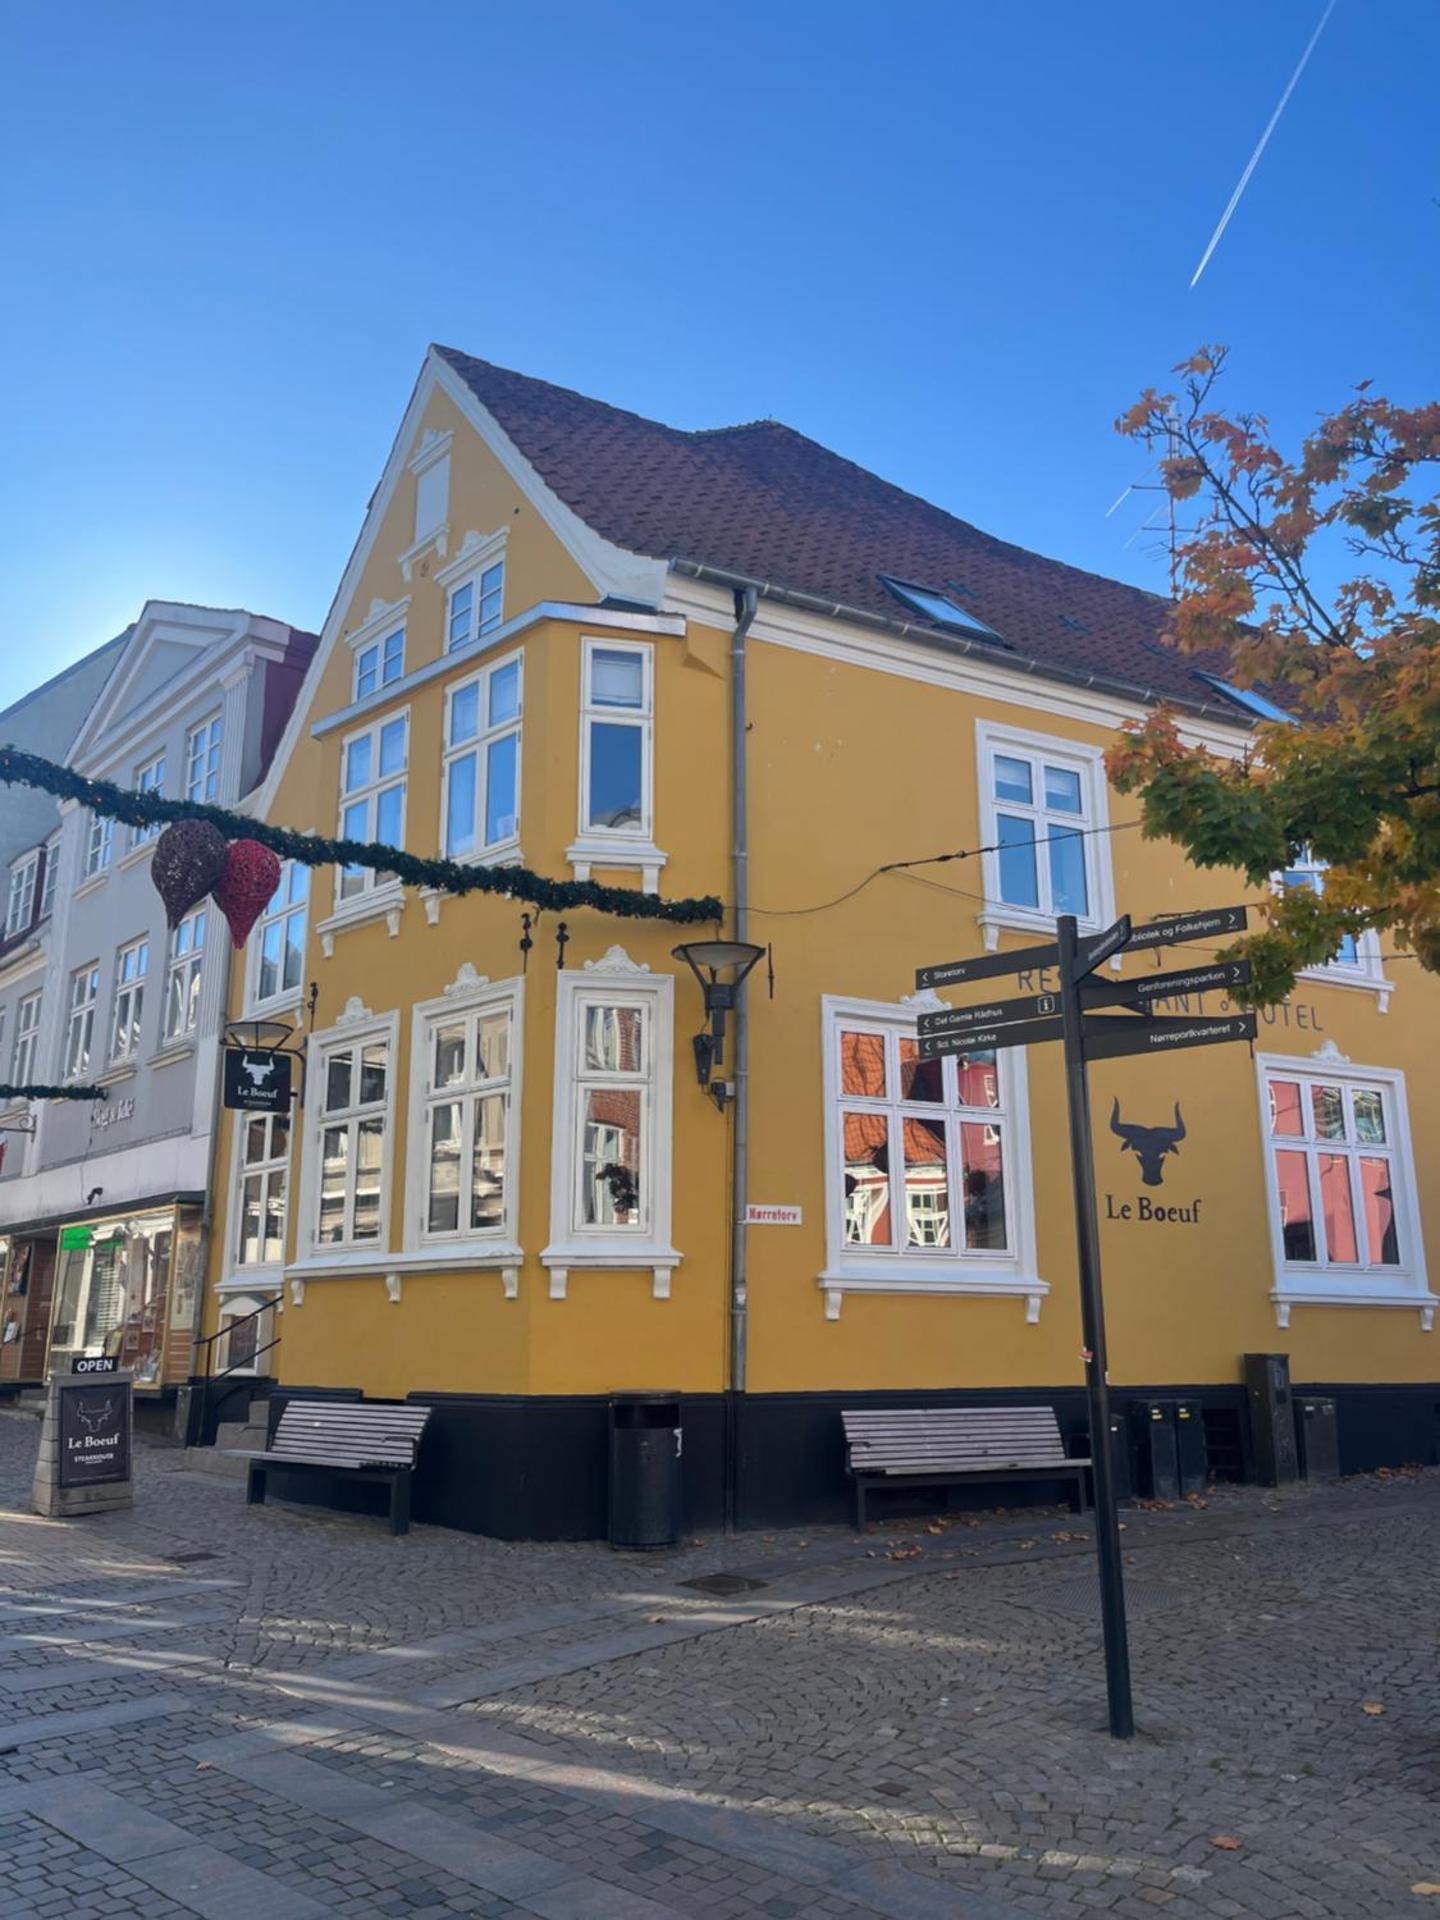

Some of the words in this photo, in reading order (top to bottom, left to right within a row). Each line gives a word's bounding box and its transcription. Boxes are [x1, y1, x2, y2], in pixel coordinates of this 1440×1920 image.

[1130, 929, 1160, 943] bliotek
[1162, 927, 1174, 938] og
[1175, 918, 1222, 935] Folkehjem
[1138, 971, 1226, 993] Genforeningsparken
[935, 1016, 948, 1026] Det
[949, 1012, 973, 1024] Gamle
[1246, 1000, 1324, 1031] OTEL
[977, 1033, 997, 1044] Kirke
[1150, 1023, 1231, 1045] Nørreportkvarteret
[237, 1086, 249, 1096] Le
[250, 1087, 279, 1099] Boeuf
[1106, 1194, 1131, 1220] Le
[1137, 1196, 1203, 1223] Boeuf
[76, 1359, 113, 1372] OPEN
[68, 1437, 82, 1450] Le
[84, 1433, 120, 1449] Boeuf
